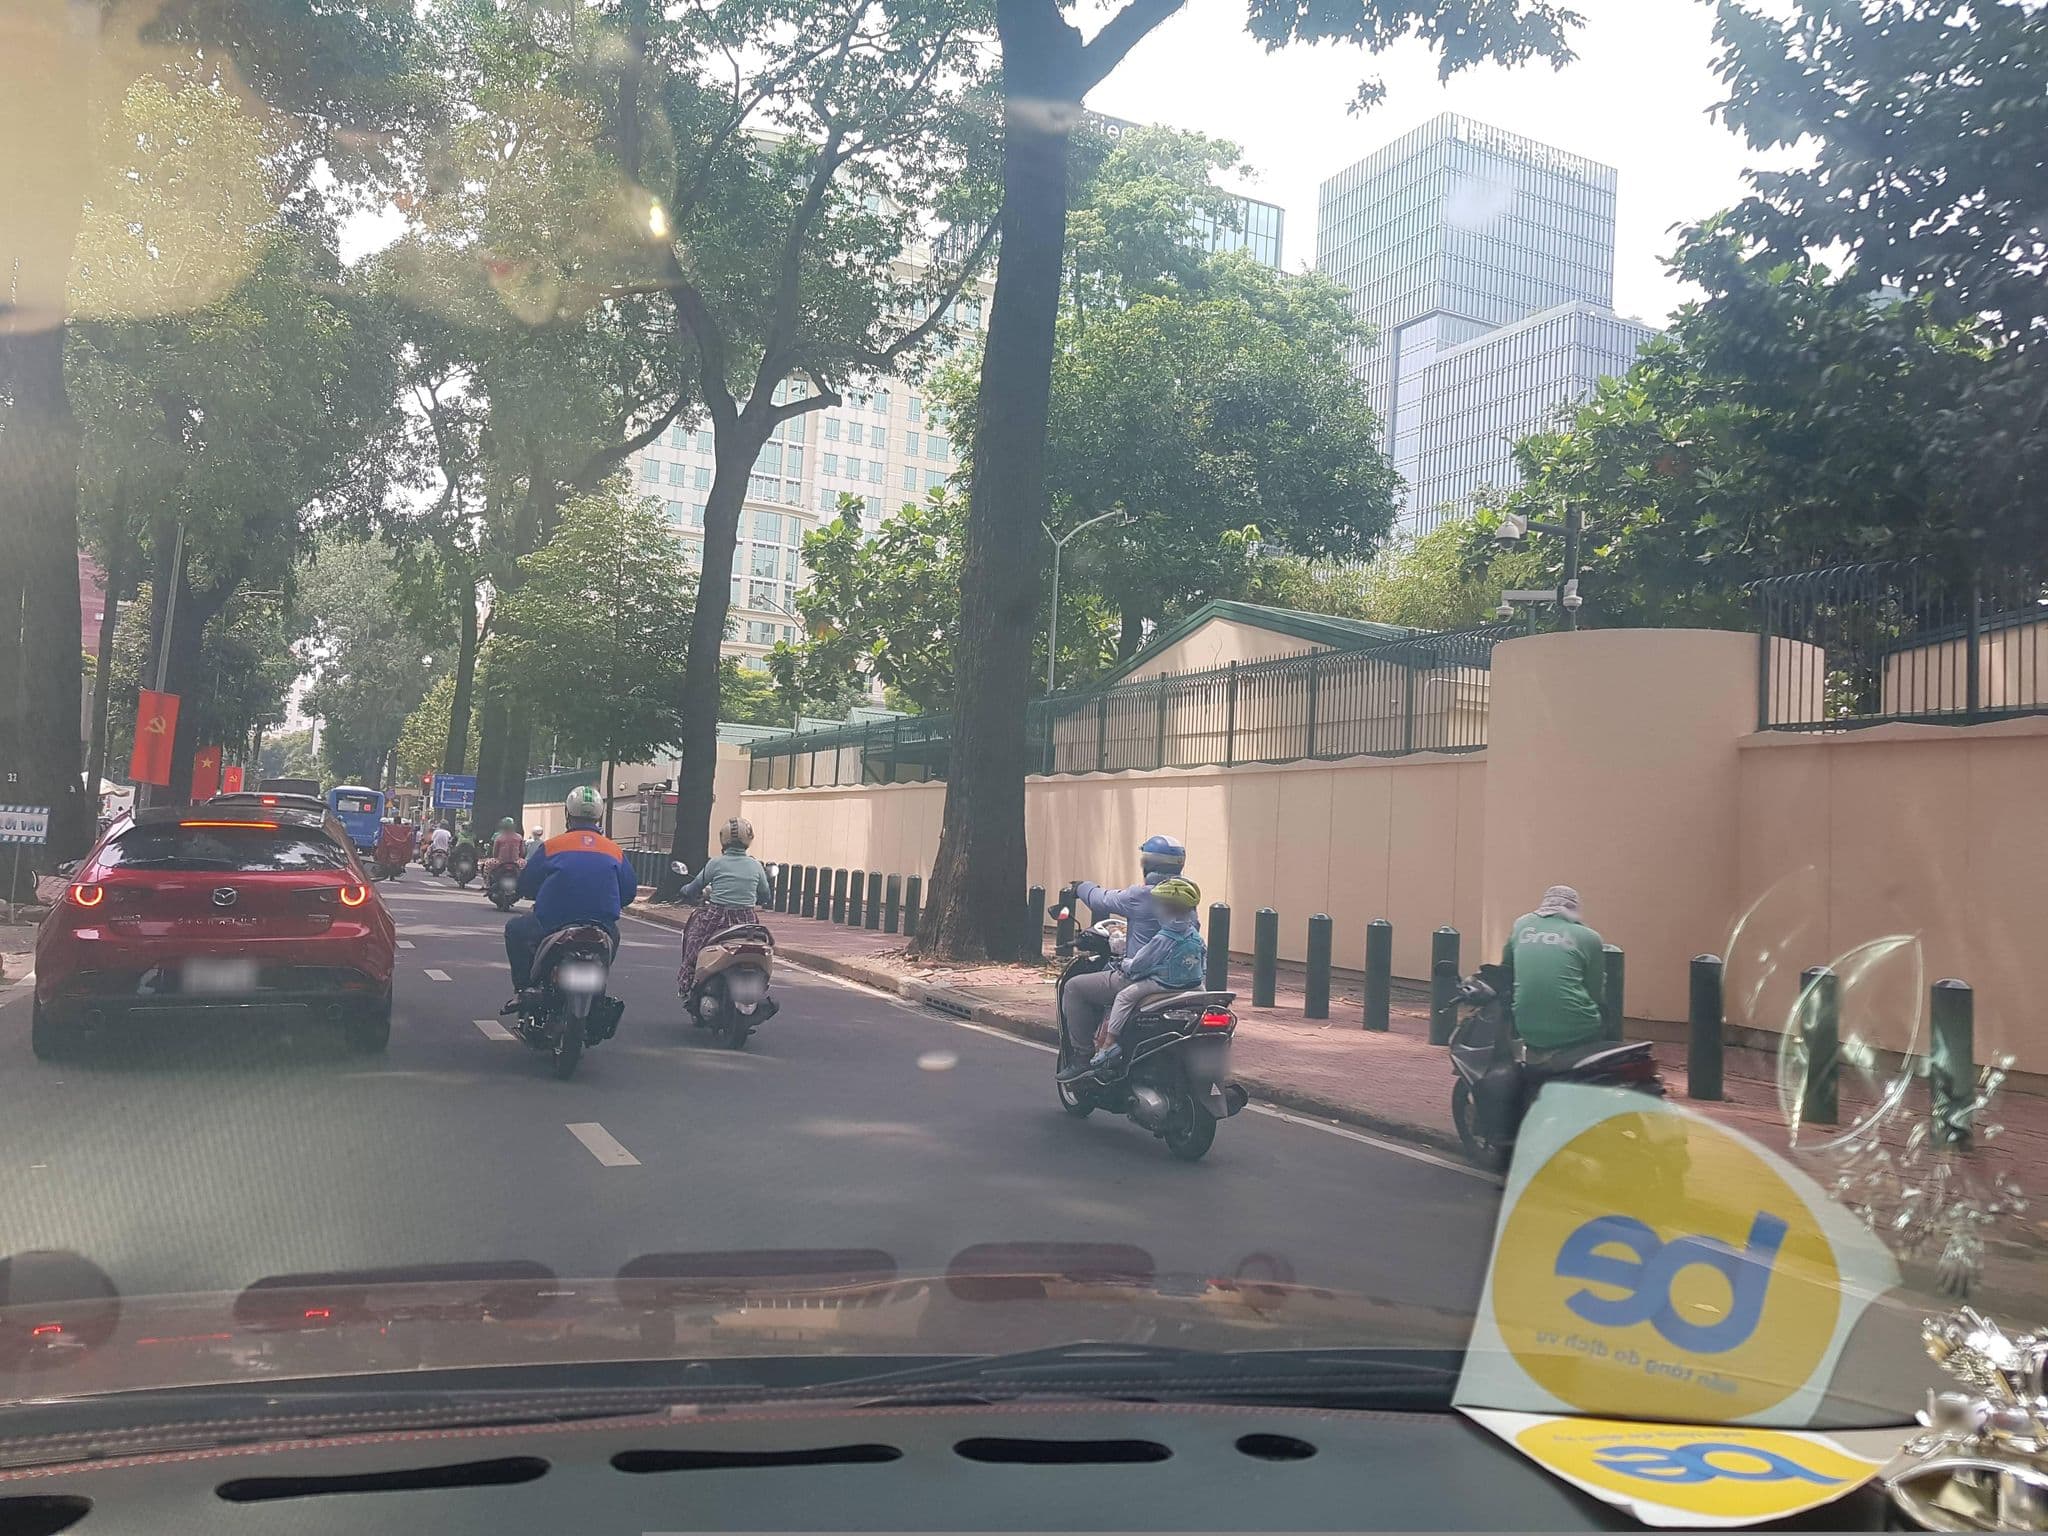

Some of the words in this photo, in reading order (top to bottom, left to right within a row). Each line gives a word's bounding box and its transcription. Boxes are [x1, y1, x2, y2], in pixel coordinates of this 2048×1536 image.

[1472, 129, 1545, 164] DEUTSCHES
[1551, 154, 1584, 175] HAUS
[1519, 927, 1577, 948] Grab
